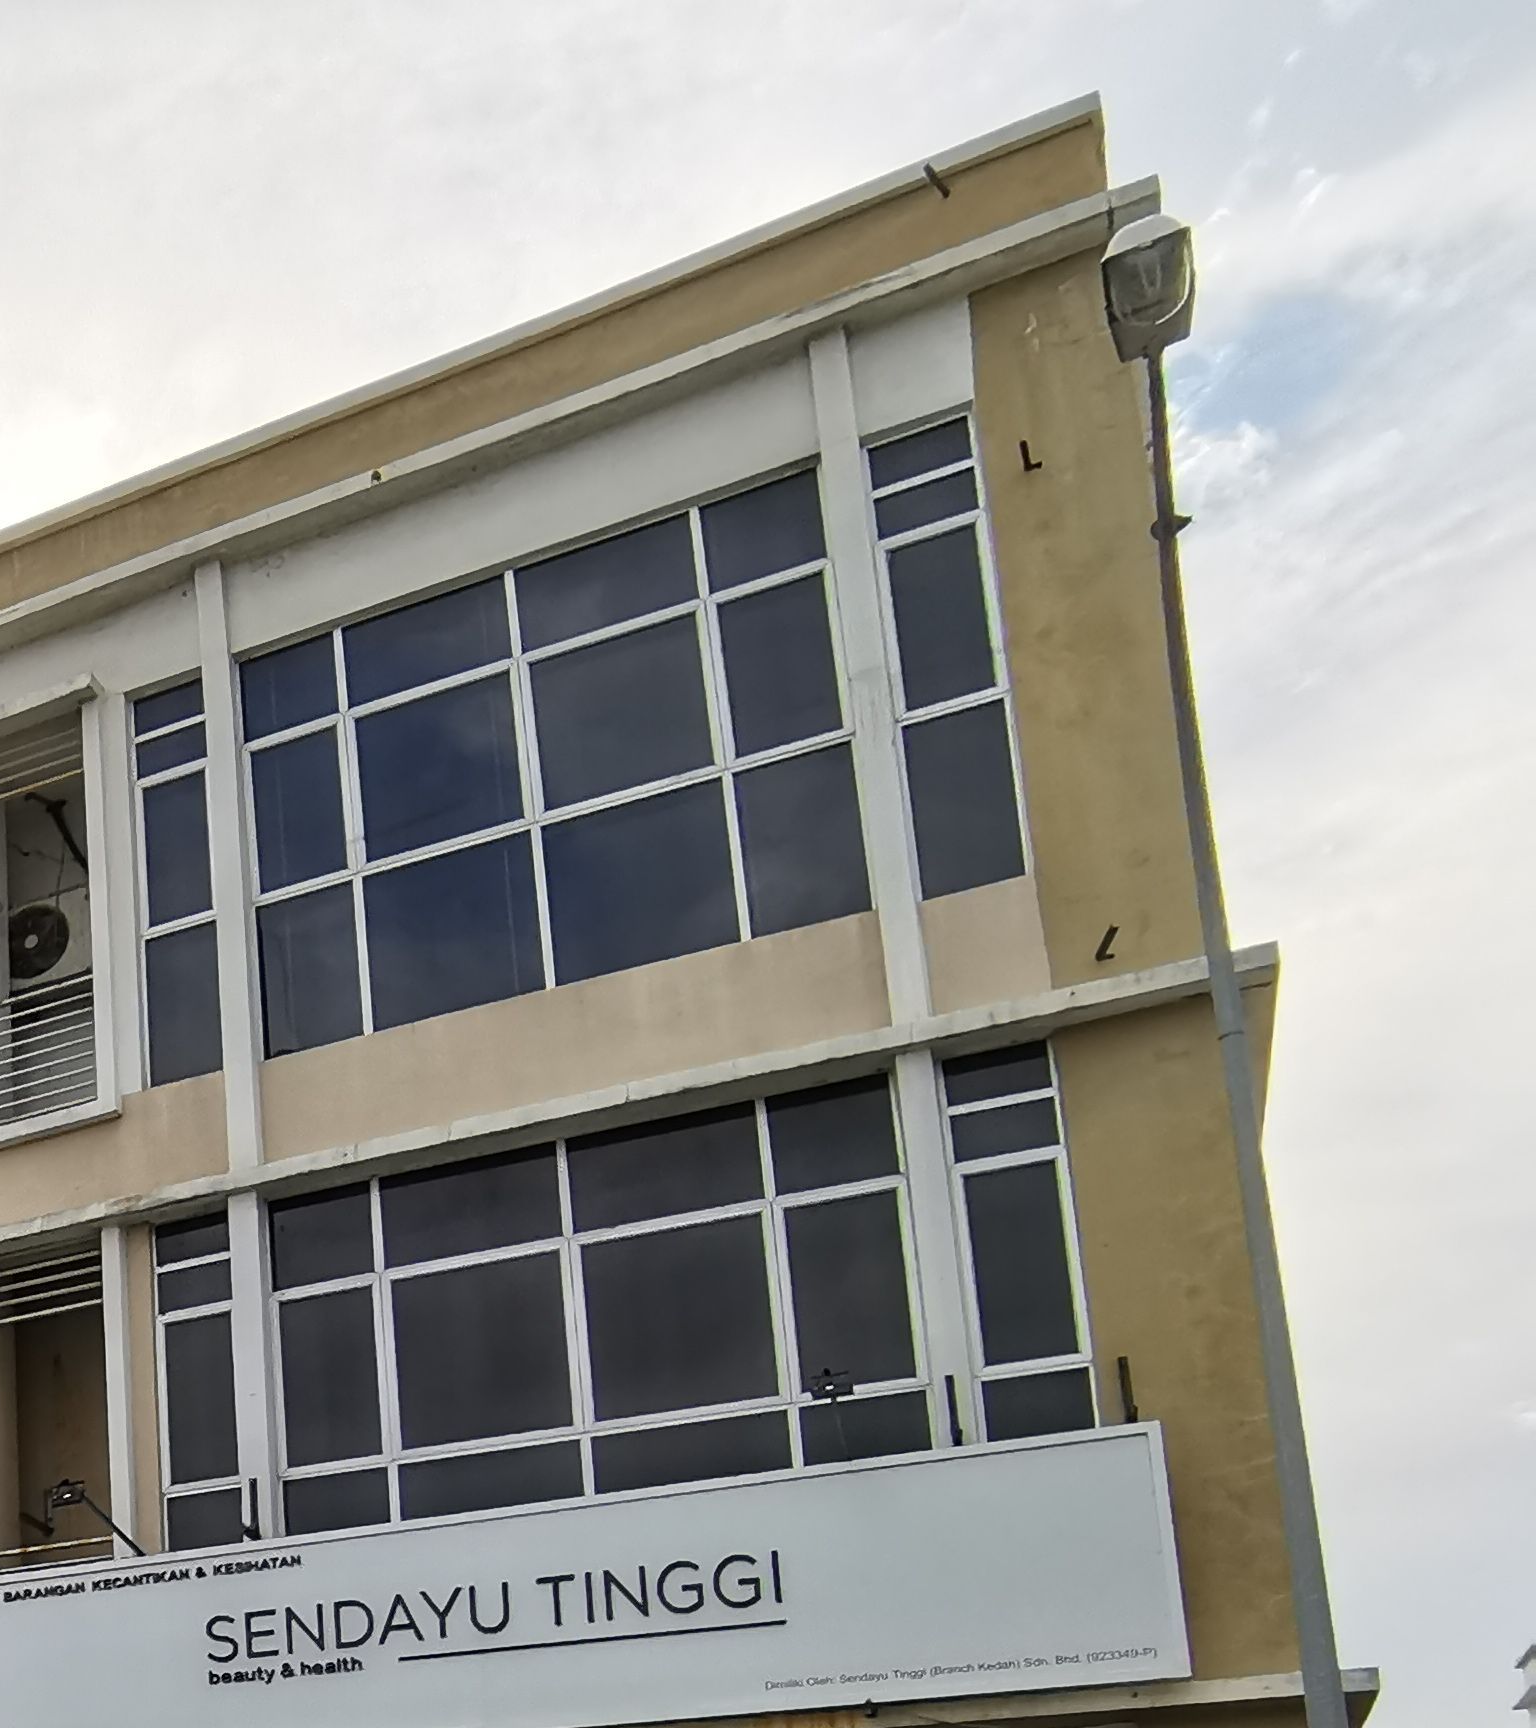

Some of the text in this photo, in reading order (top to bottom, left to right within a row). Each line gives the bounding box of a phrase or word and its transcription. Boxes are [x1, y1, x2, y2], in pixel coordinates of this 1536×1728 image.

[206, 1549, 783, 1664] SENDAYU TINGGI
[208, 1656, 363, 1686] beauty & health
